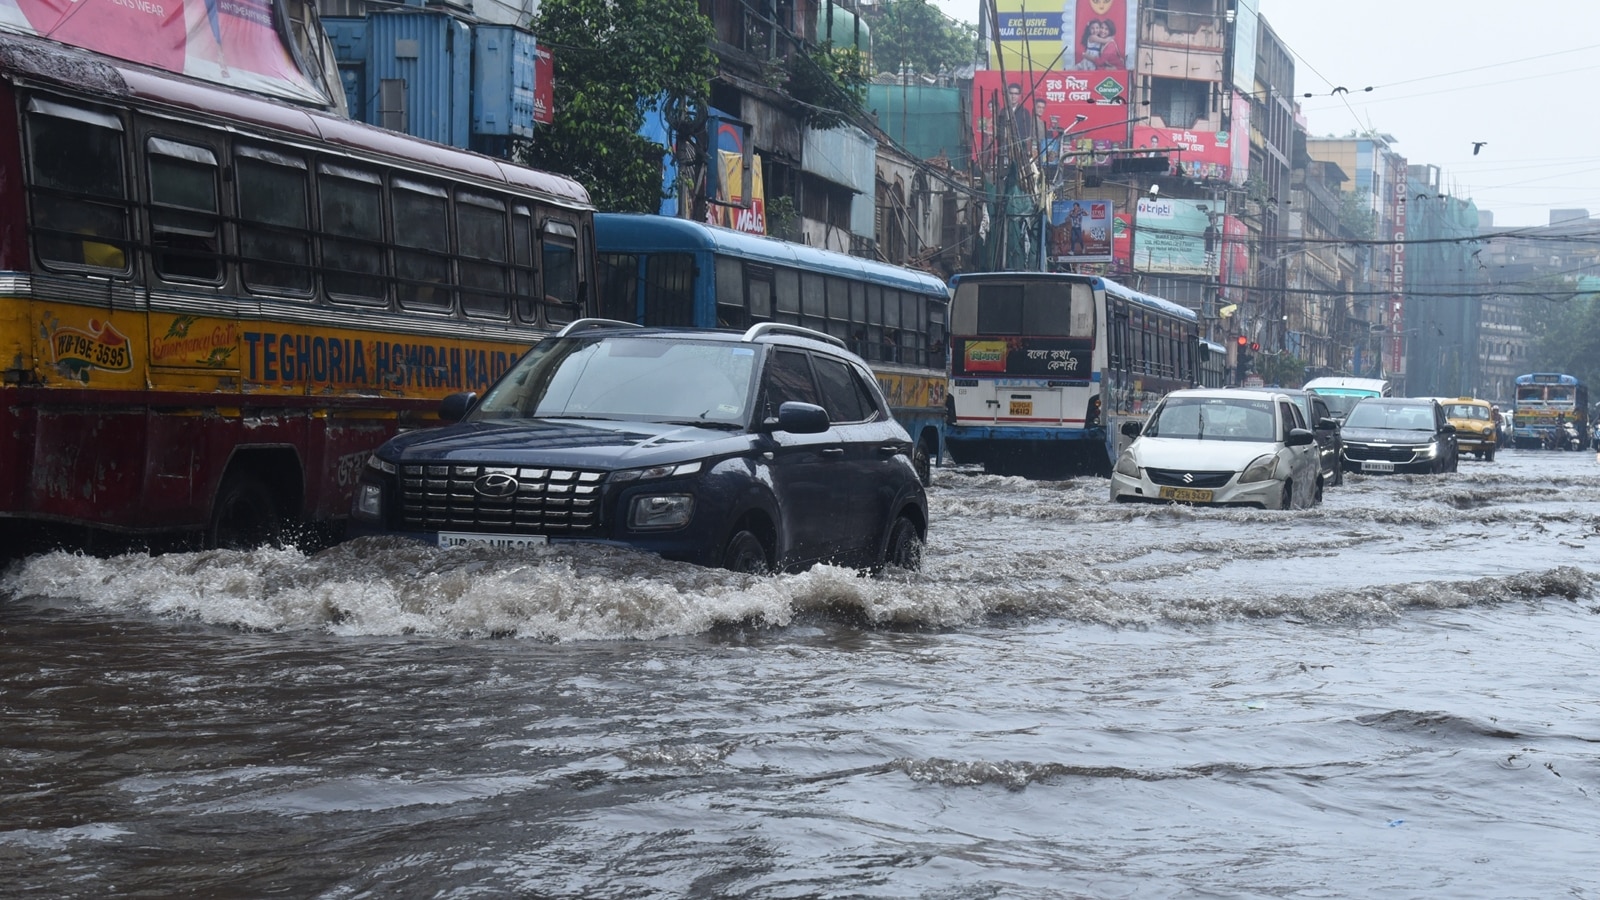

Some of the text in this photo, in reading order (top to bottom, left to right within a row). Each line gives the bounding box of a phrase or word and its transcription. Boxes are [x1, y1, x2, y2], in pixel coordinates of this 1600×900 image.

[136, 0, 165, 17] WEAR
[1146, 204, 1171, 216] tripti
[243, 332, 367, 385] TEGHORIA
